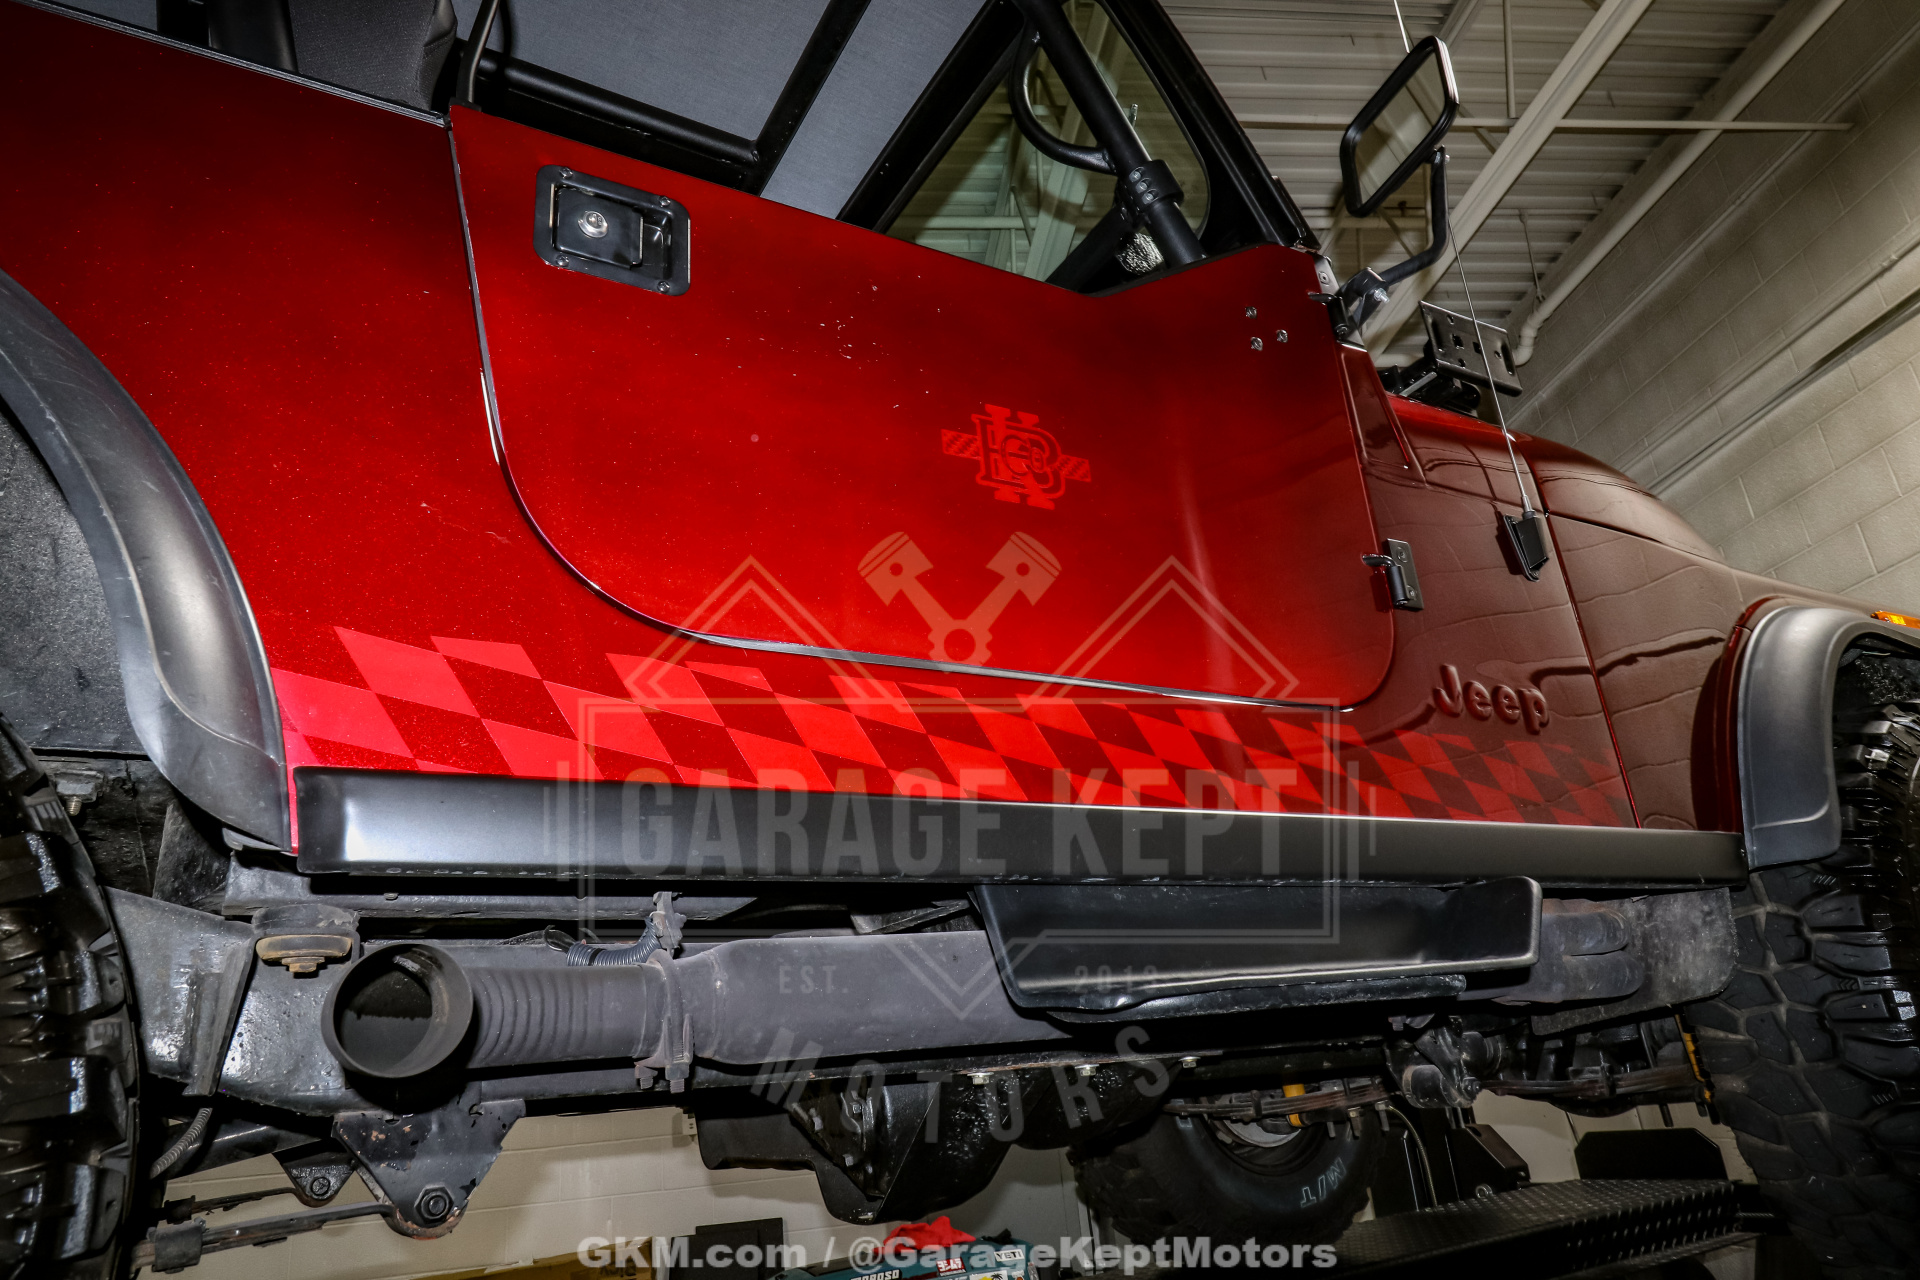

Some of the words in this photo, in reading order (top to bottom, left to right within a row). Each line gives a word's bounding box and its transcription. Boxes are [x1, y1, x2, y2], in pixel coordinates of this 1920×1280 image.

[1433, 664, 1549, 735] Jeep
[995, 1251, 1022, 1259] YETI
[850, 1269, 900, 1280] OROSO
